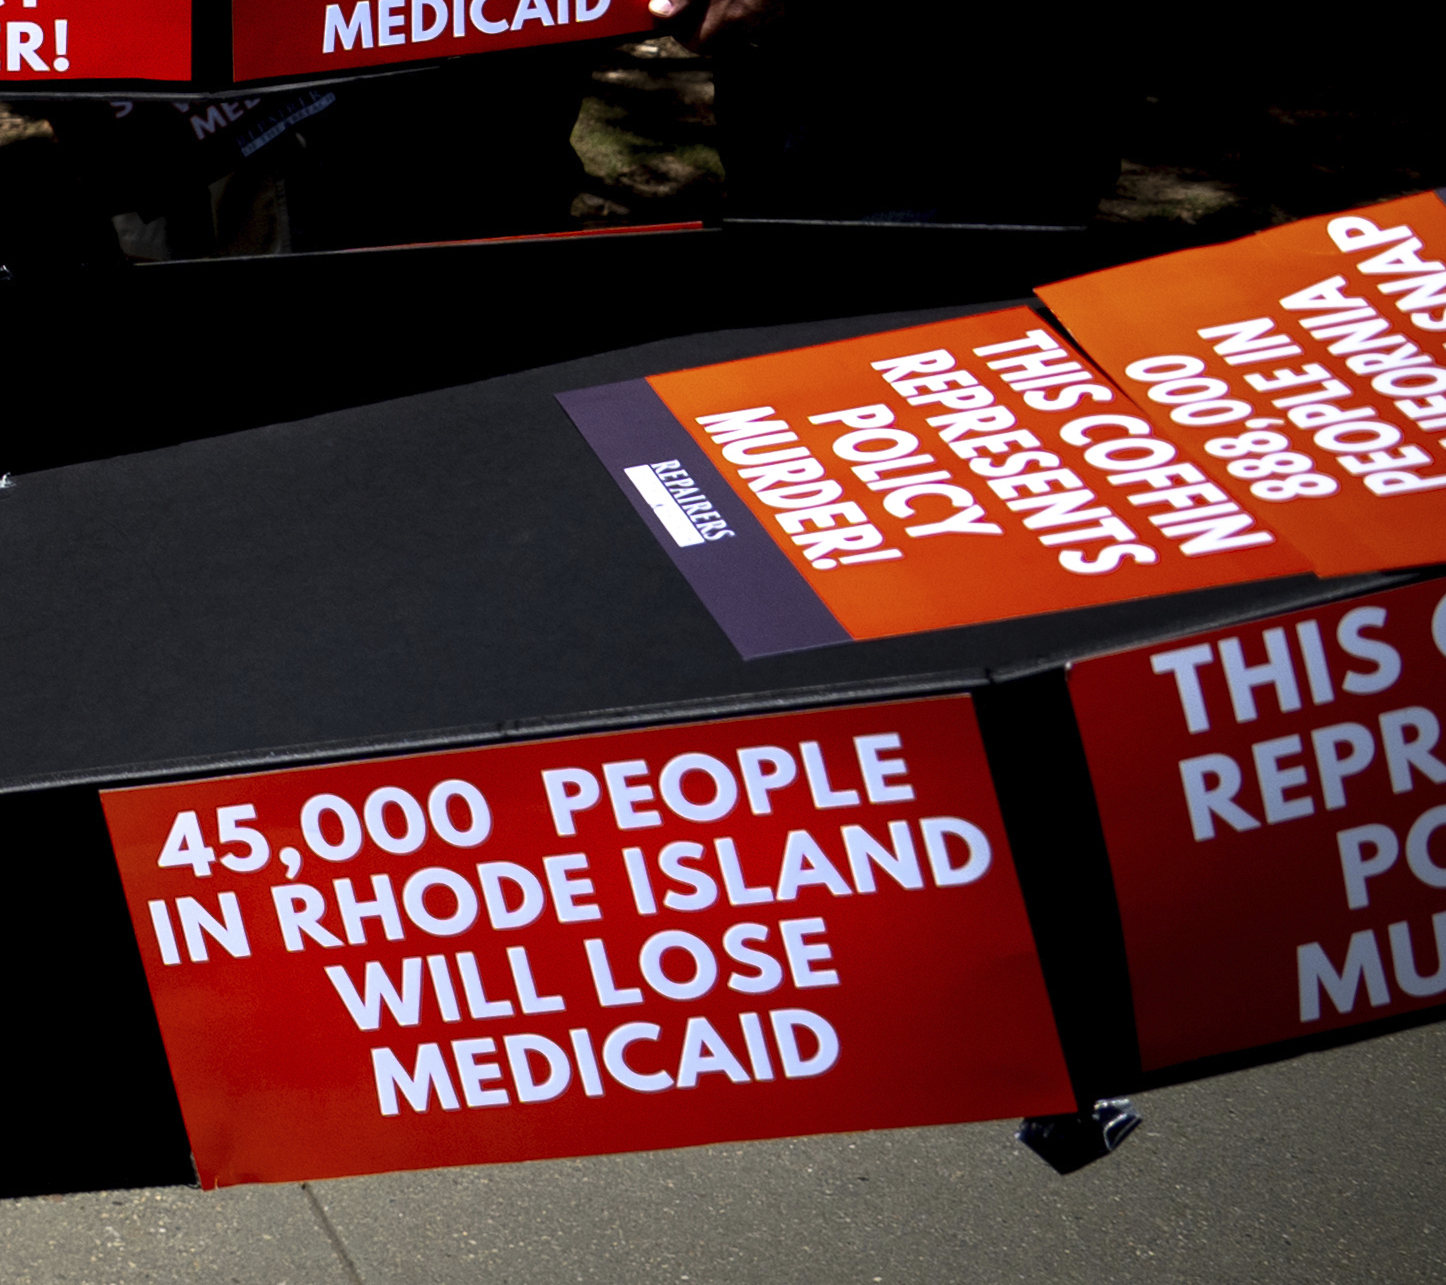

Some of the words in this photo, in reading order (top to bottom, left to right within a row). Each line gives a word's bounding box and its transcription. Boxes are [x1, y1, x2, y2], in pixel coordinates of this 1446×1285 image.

[1197, 317, 1303, 365] IN
[695, 406, 903, 570] MURDER!
[808, 403, 1003, 538] POLICY
[870, 348, 1157, 574] REPRESENTS
[973, 328, 1114, 411] THIS
[1059, 414, 1274, 556] COFFIN
[1125, 354, 1339, 501] 888,000
[1244, 362, 1446, 496] PEOPLE
[649, 458, 736, 542] REPAIRERS
[1149, 606, 1402, 734] THIS
[158, 779, 491, 879] 45,000
[542, 734, 914, 836] PEOPLE
[148, 892, 251, 965] IN
[271, 853, 601, 952] RHODE
[622, 817, 990, 915] ISLAND
[325, 946, 565, 1031] WILL
[584, 917, 839, 1007] LOSE
[371, 1009, 838, 1116] MEDICAID
